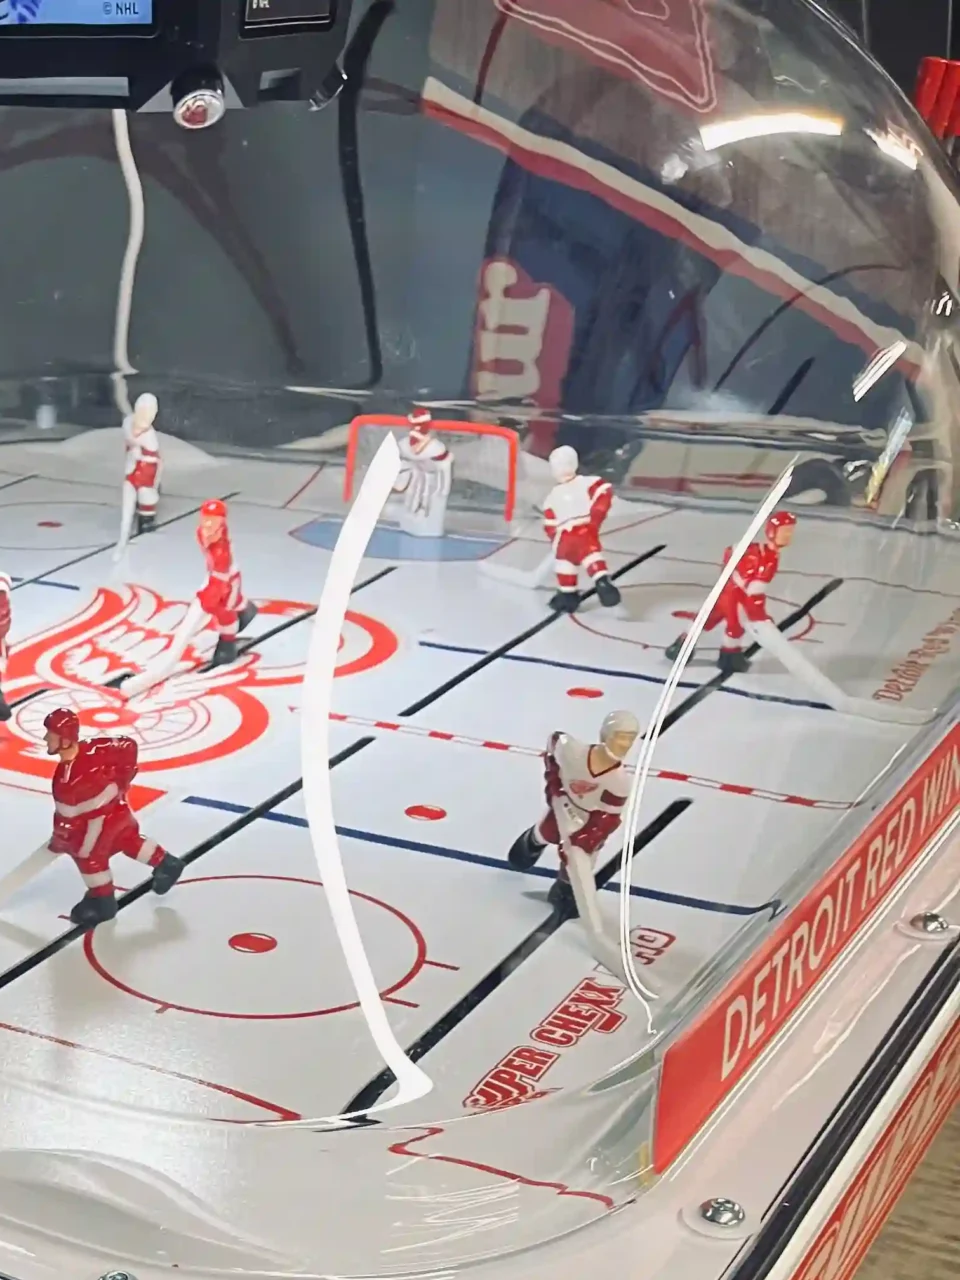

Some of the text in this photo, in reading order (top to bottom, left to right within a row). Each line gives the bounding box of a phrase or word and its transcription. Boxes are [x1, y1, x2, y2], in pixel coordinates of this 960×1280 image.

[115, 2, 139, 15] NHL
[720, 857, 862, 1082] DETROIT
[861, 796, 916, 910] RED
[529, 976, 628, 1047] CHEXX
